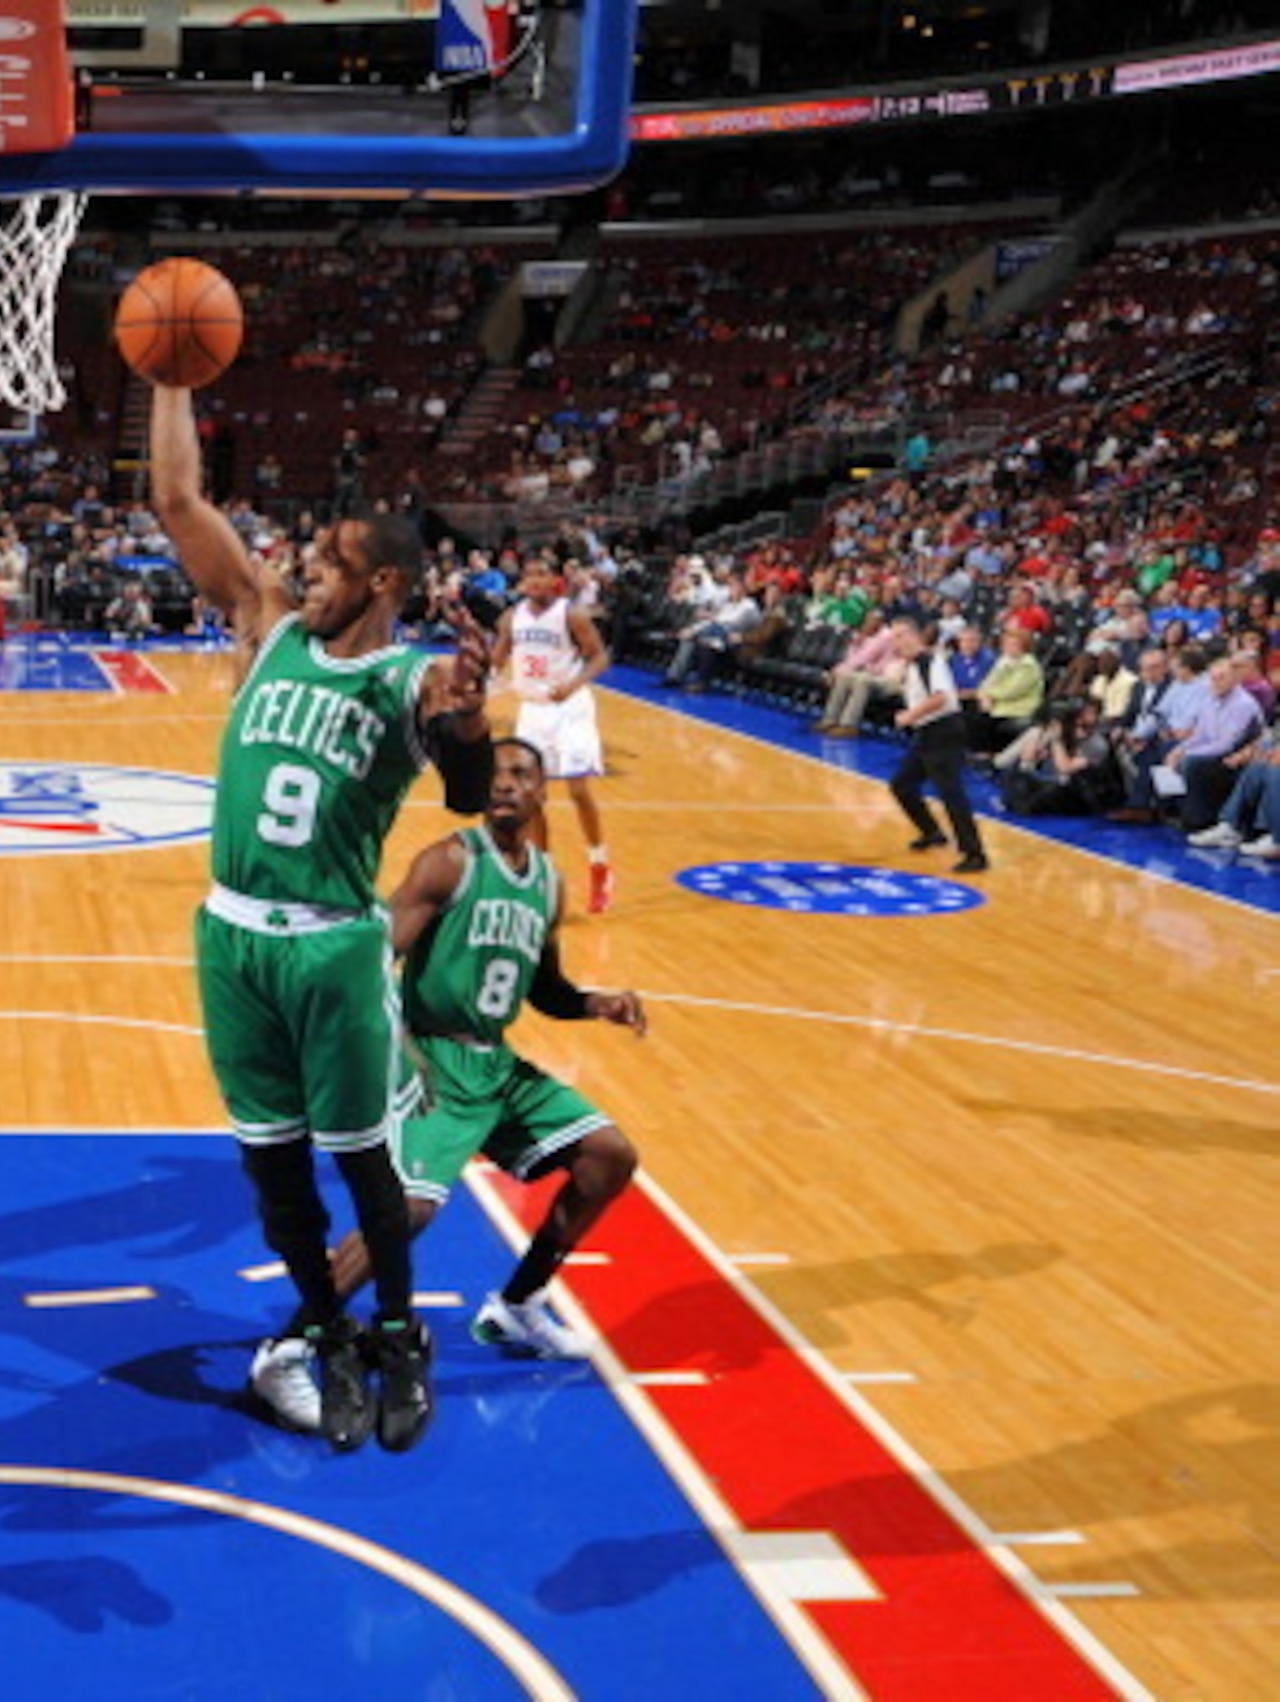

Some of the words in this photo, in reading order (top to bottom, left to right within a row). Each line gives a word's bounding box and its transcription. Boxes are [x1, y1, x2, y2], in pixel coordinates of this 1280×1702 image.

[240, 679, 387, 781] CELTICS
[256, 761, 322, 848] 9
[476, 957, 520, 1019] 8
